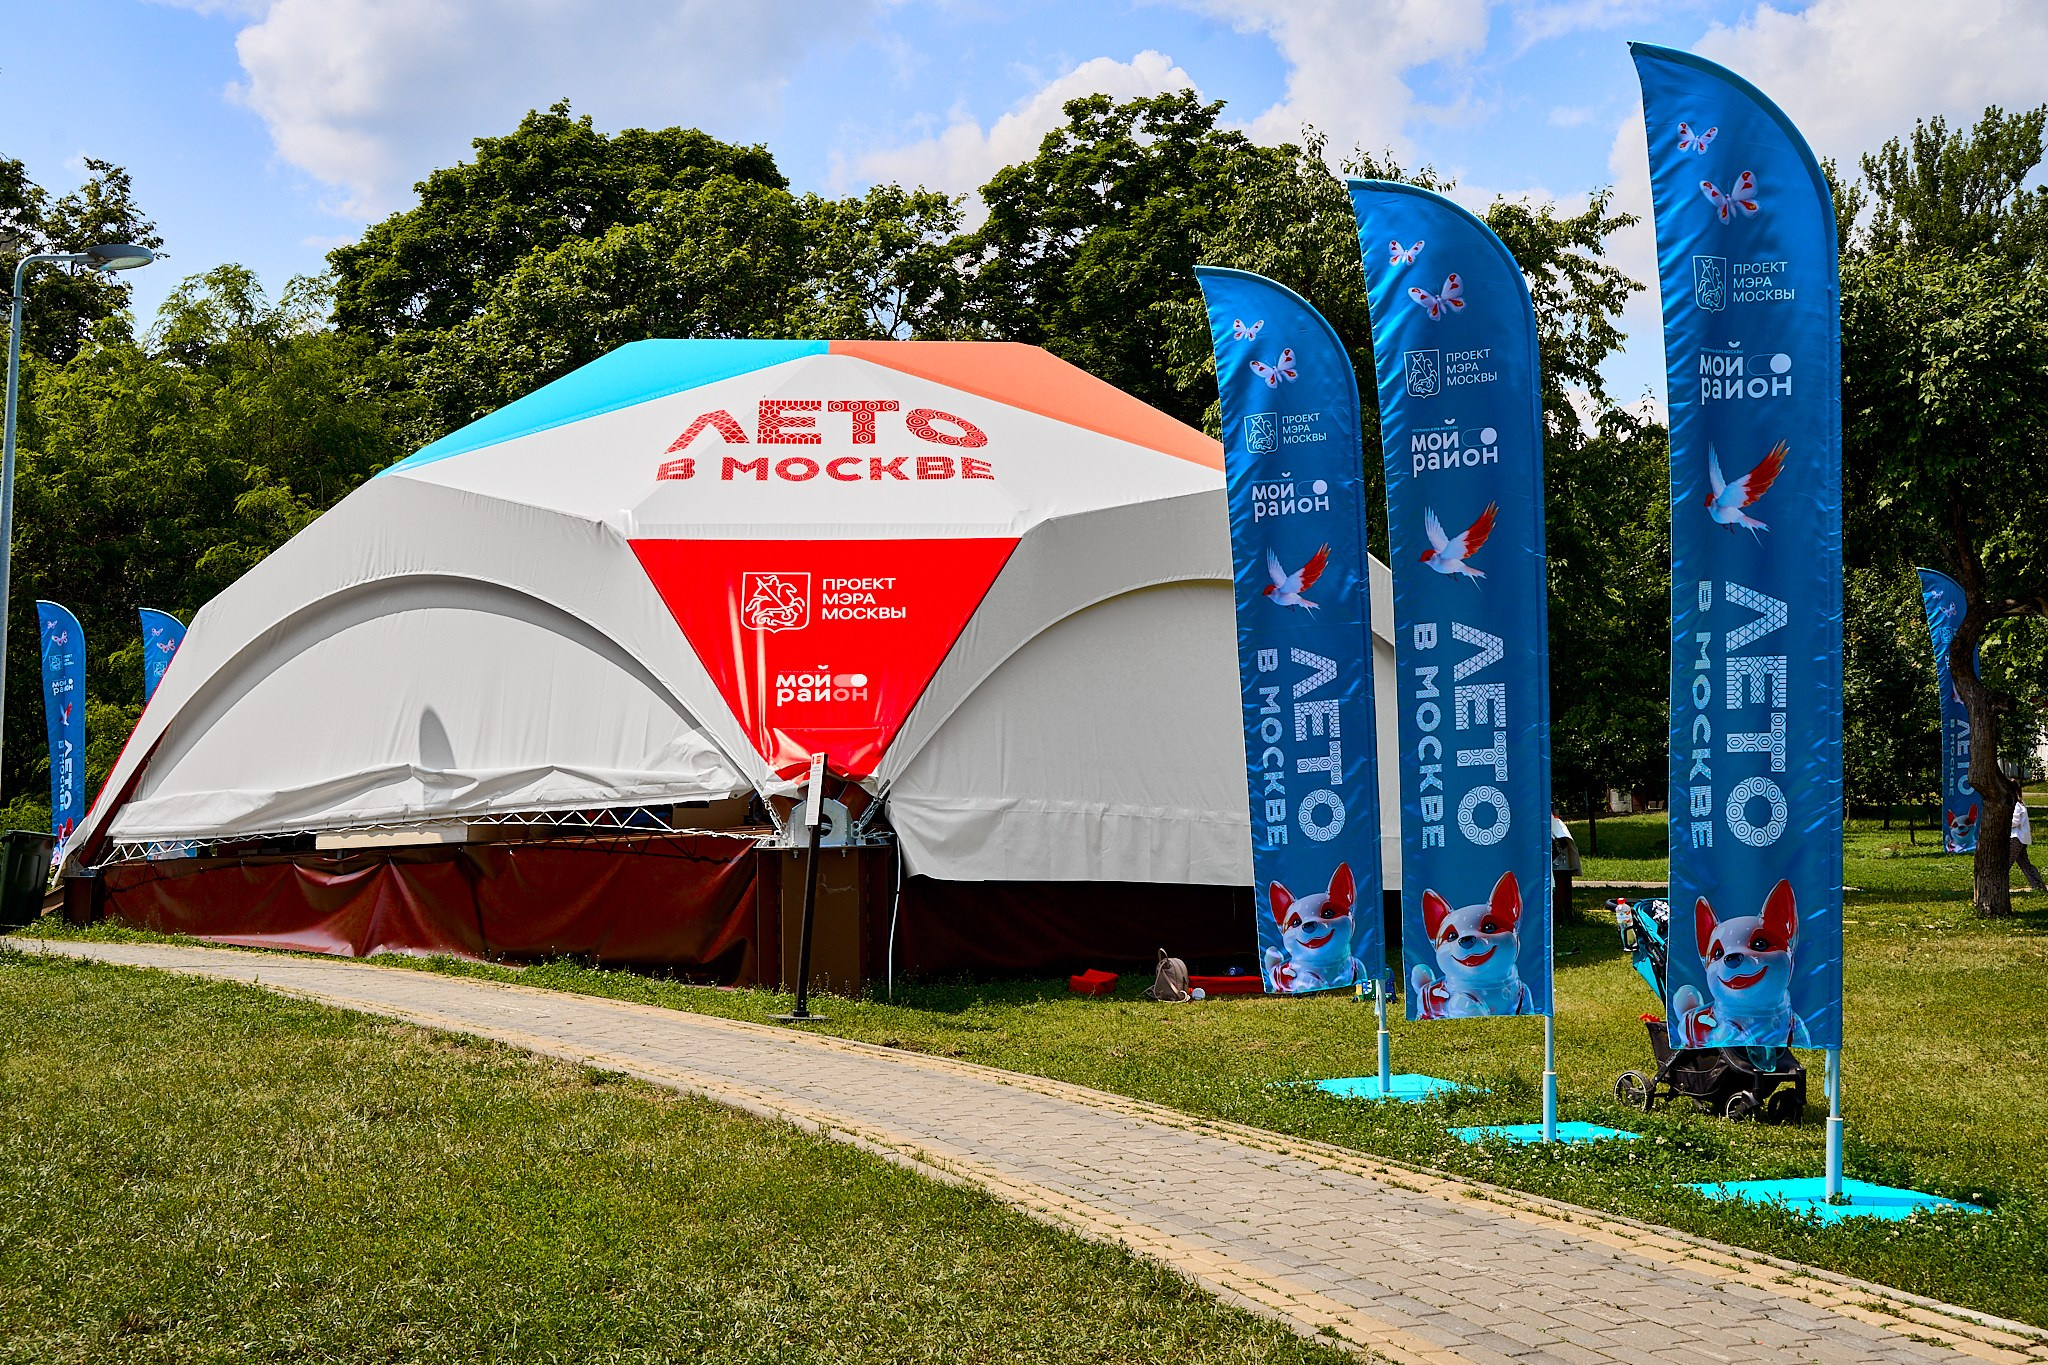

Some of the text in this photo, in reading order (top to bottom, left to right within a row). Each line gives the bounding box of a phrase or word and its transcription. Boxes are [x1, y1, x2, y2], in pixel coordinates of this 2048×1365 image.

[1733, 261, 1788, 275] ПРОЕКТ
[1733, 276, 1772, 289] МЭРА
[1733, 288, 1795, 303] МОСКВЫ
[1446, 348, 1491, 363] ПРОЕКТ
[1446, 362, 1479, 374] МЭРА
[1446, 371, 1498, 386] МОСКВЫ
[1282, 412, 1320, 424] ПРОЕКТ
[663, 400, 989, 454] ЛЕТО
[1282, 424, 1311, 434] МЭРА
[1283, 432, 1327, 444] МОСКВЫ
[656, 456, 995, 482] В МОСКВЕ
[822, 577, 896, 590] ПРОЕКТ
[822, 593, 876, 605] МЭРА
[822, 606, 906, 620] МОСКВЫ
[1689, 580, 1713, 849] В МОСКВЕ
[1725, 580, 1788, 848] ЛЕТО
[1413, 622, 1445, 849] В МОСКВЕ
[1451, 621, 1511, 846] ЛЕТО
[1257, 648, 1288, 846] В МОСКВЕ
[1290, 647, 1346, 842] ЛЕТО
